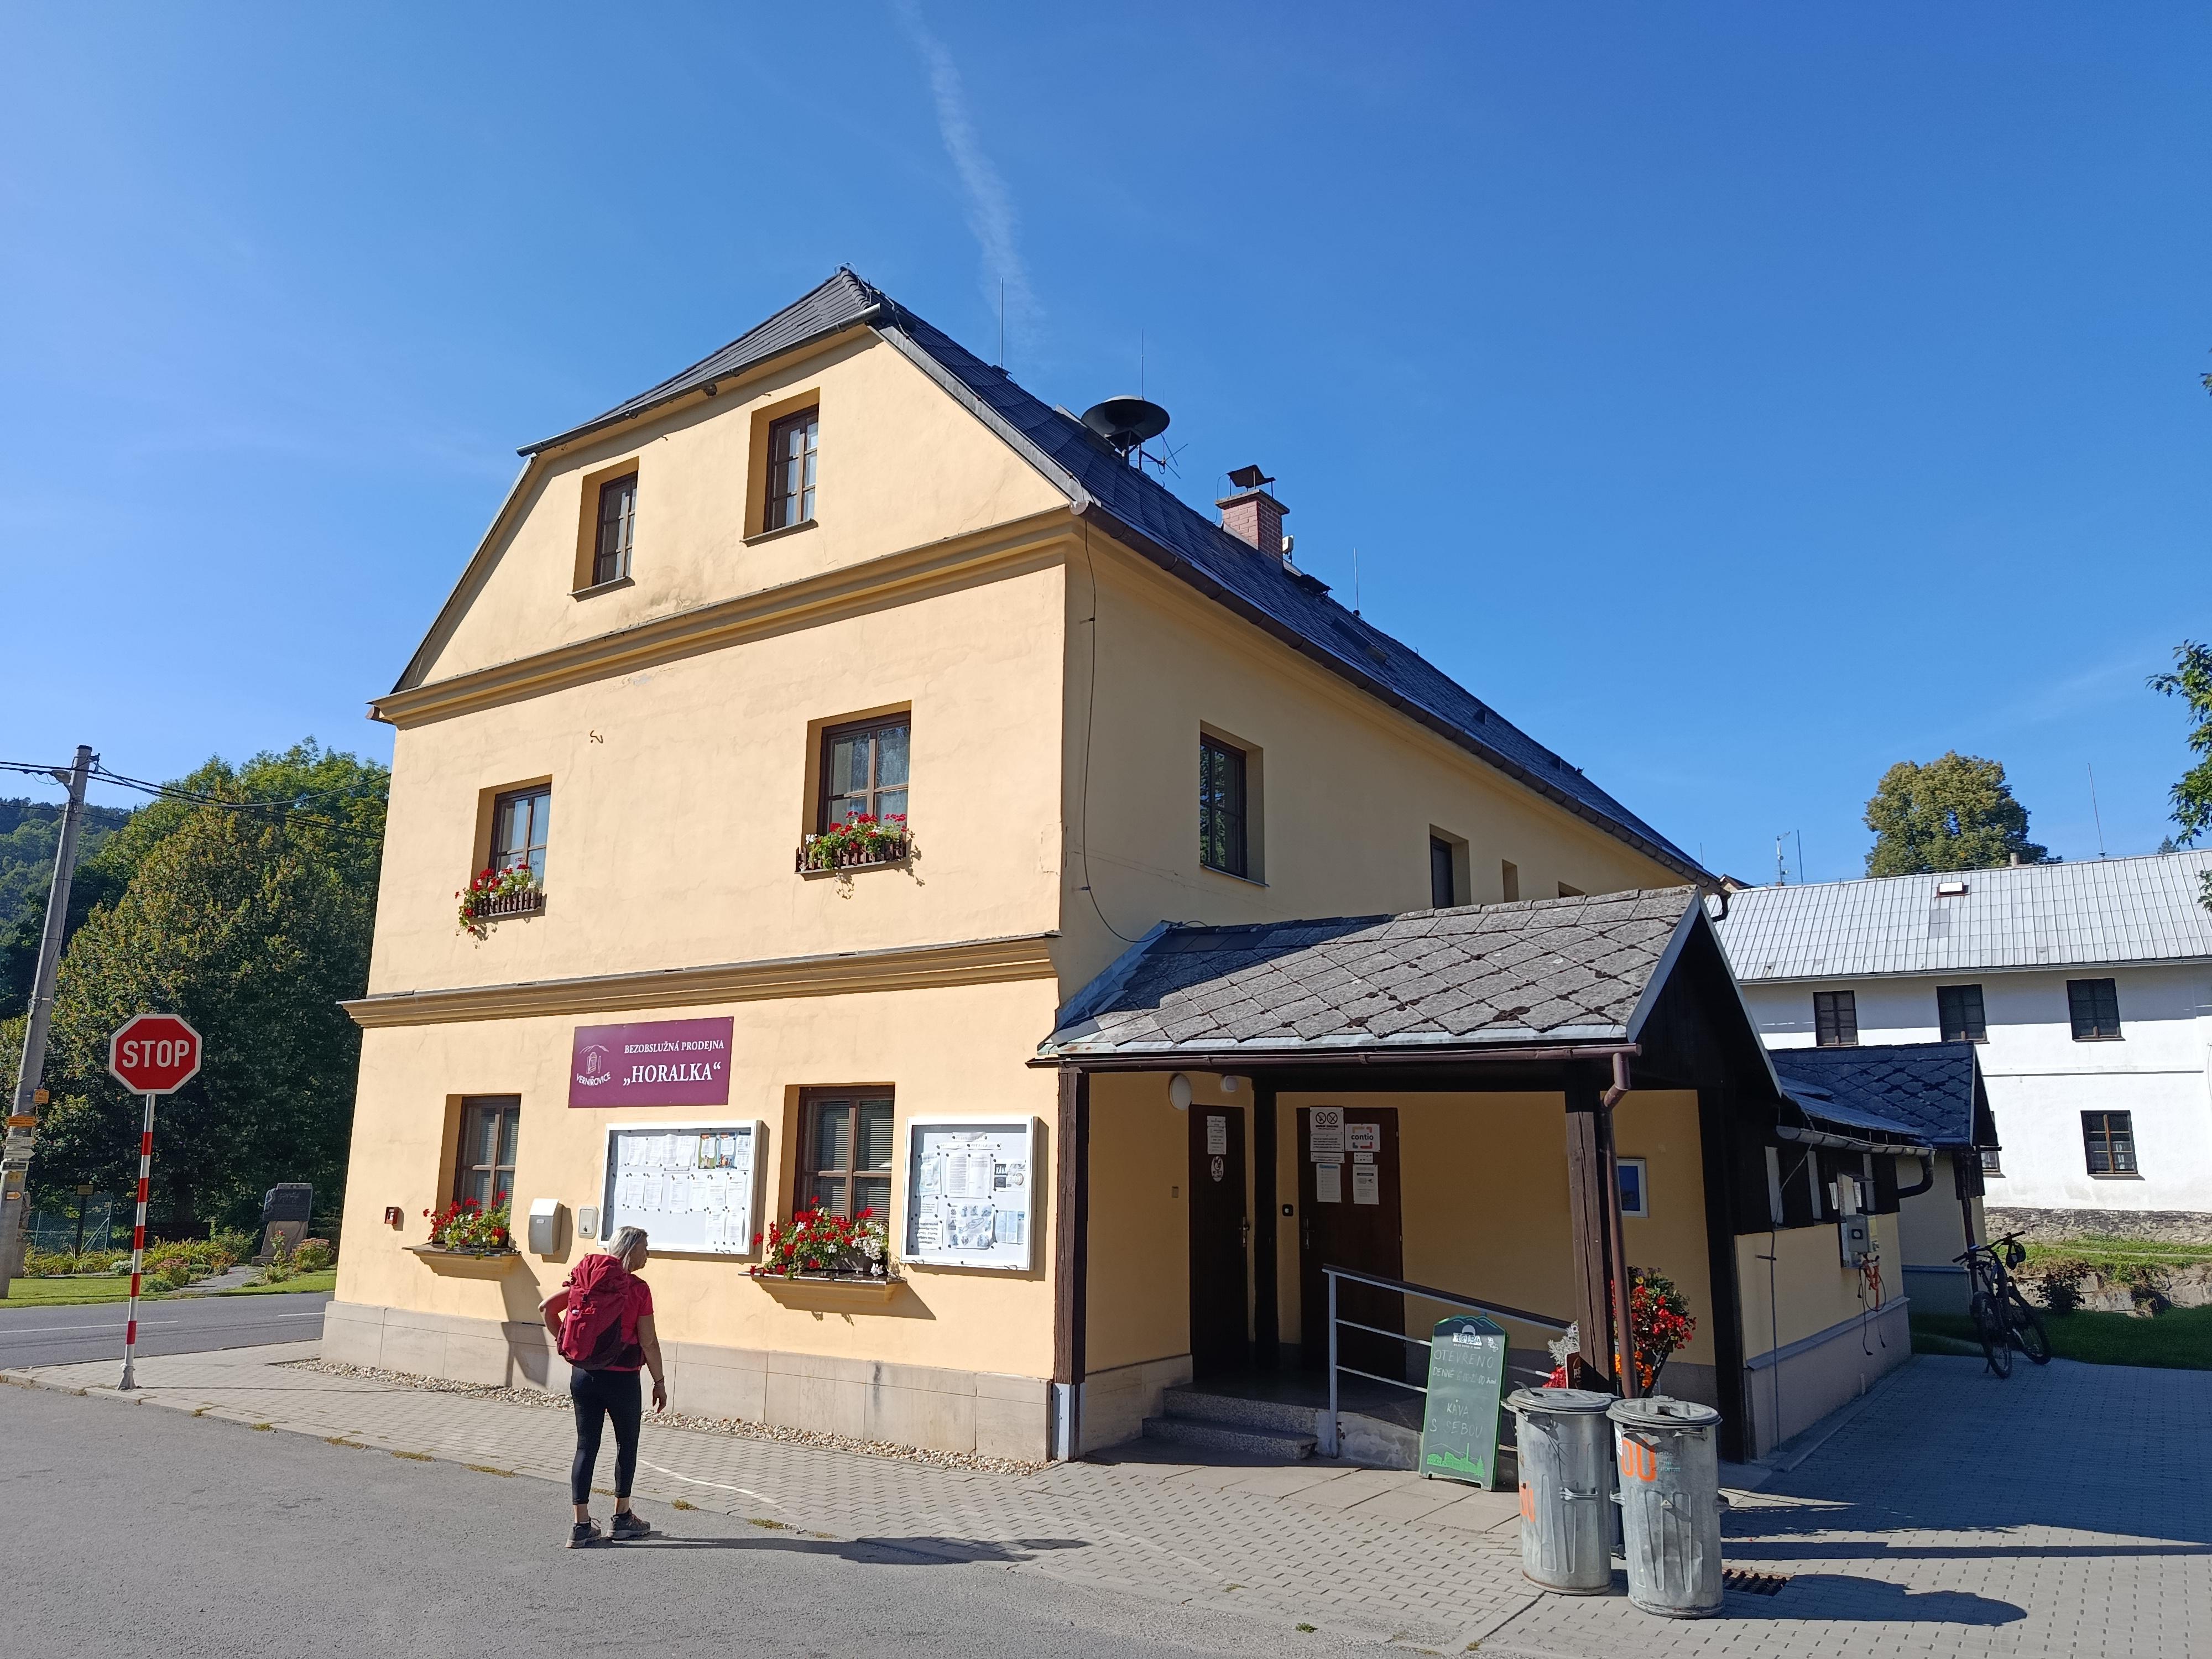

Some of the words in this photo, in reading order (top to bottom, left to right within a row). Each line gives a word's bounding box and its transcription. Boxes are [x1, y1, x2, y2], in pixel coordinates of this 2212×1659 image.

[122, 1040, 190, 1068] STOP
[624, 1041, 679, 1053] BEZOBSLUŽNÁ
[681, 1040, 724, 1052] PRODEJNA
[623, 1061, 722, 1086] „HORALKA“
[1434, 1349, 1494, 1368] OTEVŘENO
[1430, 1418, 1437, 1432] S
